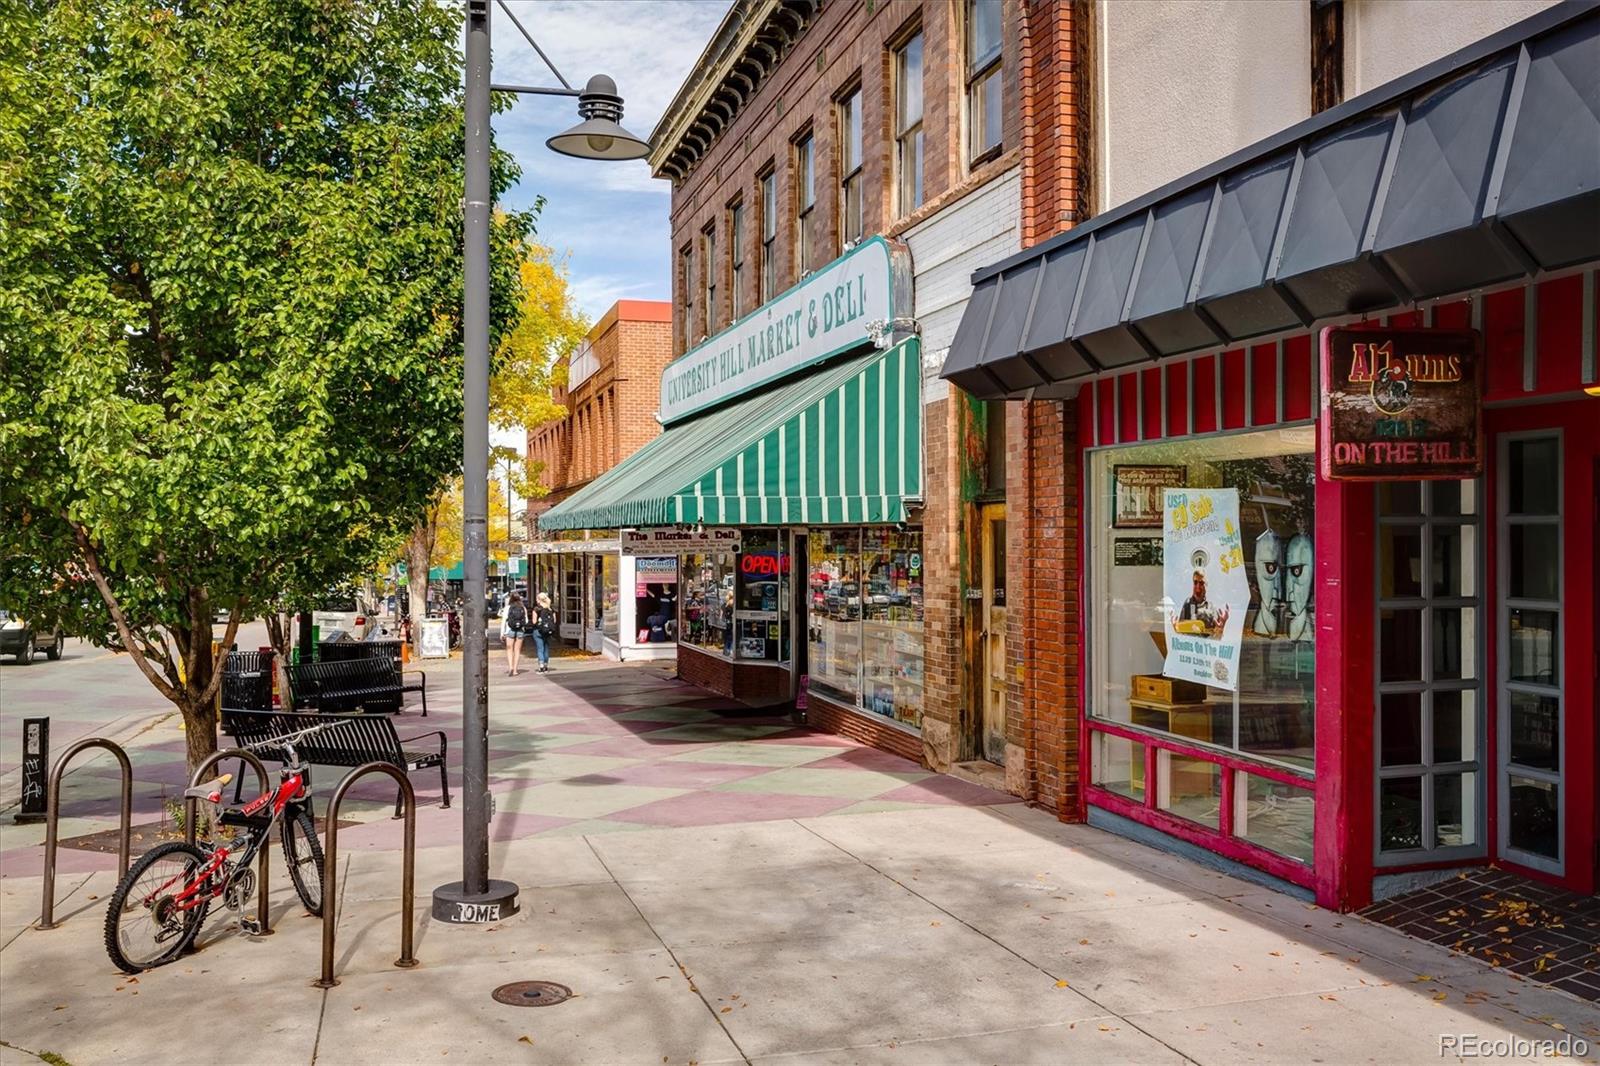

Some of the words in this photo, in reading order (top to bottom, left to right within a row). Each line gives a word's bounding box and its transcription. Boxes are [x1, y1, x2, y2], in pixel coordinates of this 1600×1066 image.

[667, 355, 717, 405] UNIVERSITY
[720, 343, 744, 382] HILL
[747, 308, 802, 369] MARKET
[808, 299, 817, 338] &
[822, 273, 866, 333] DELI
[1347, 340, 1463, 396] Albums
[1334, 442, 1366, 465] ON
[1368, 441, 1418, 465] THE
[1421, 441, 1476, 464] HILL
[627, 531, 648, 541] The
[714, 530, 735, 540] Deli
[741, 553, 779, 575] OPEN
[1171, 637, 1194, 653] Albums
[1194, 641, 1204, 654] On
[1204, 642, 1217, 657] The
[1218, 645, 1235, 660] Hill
